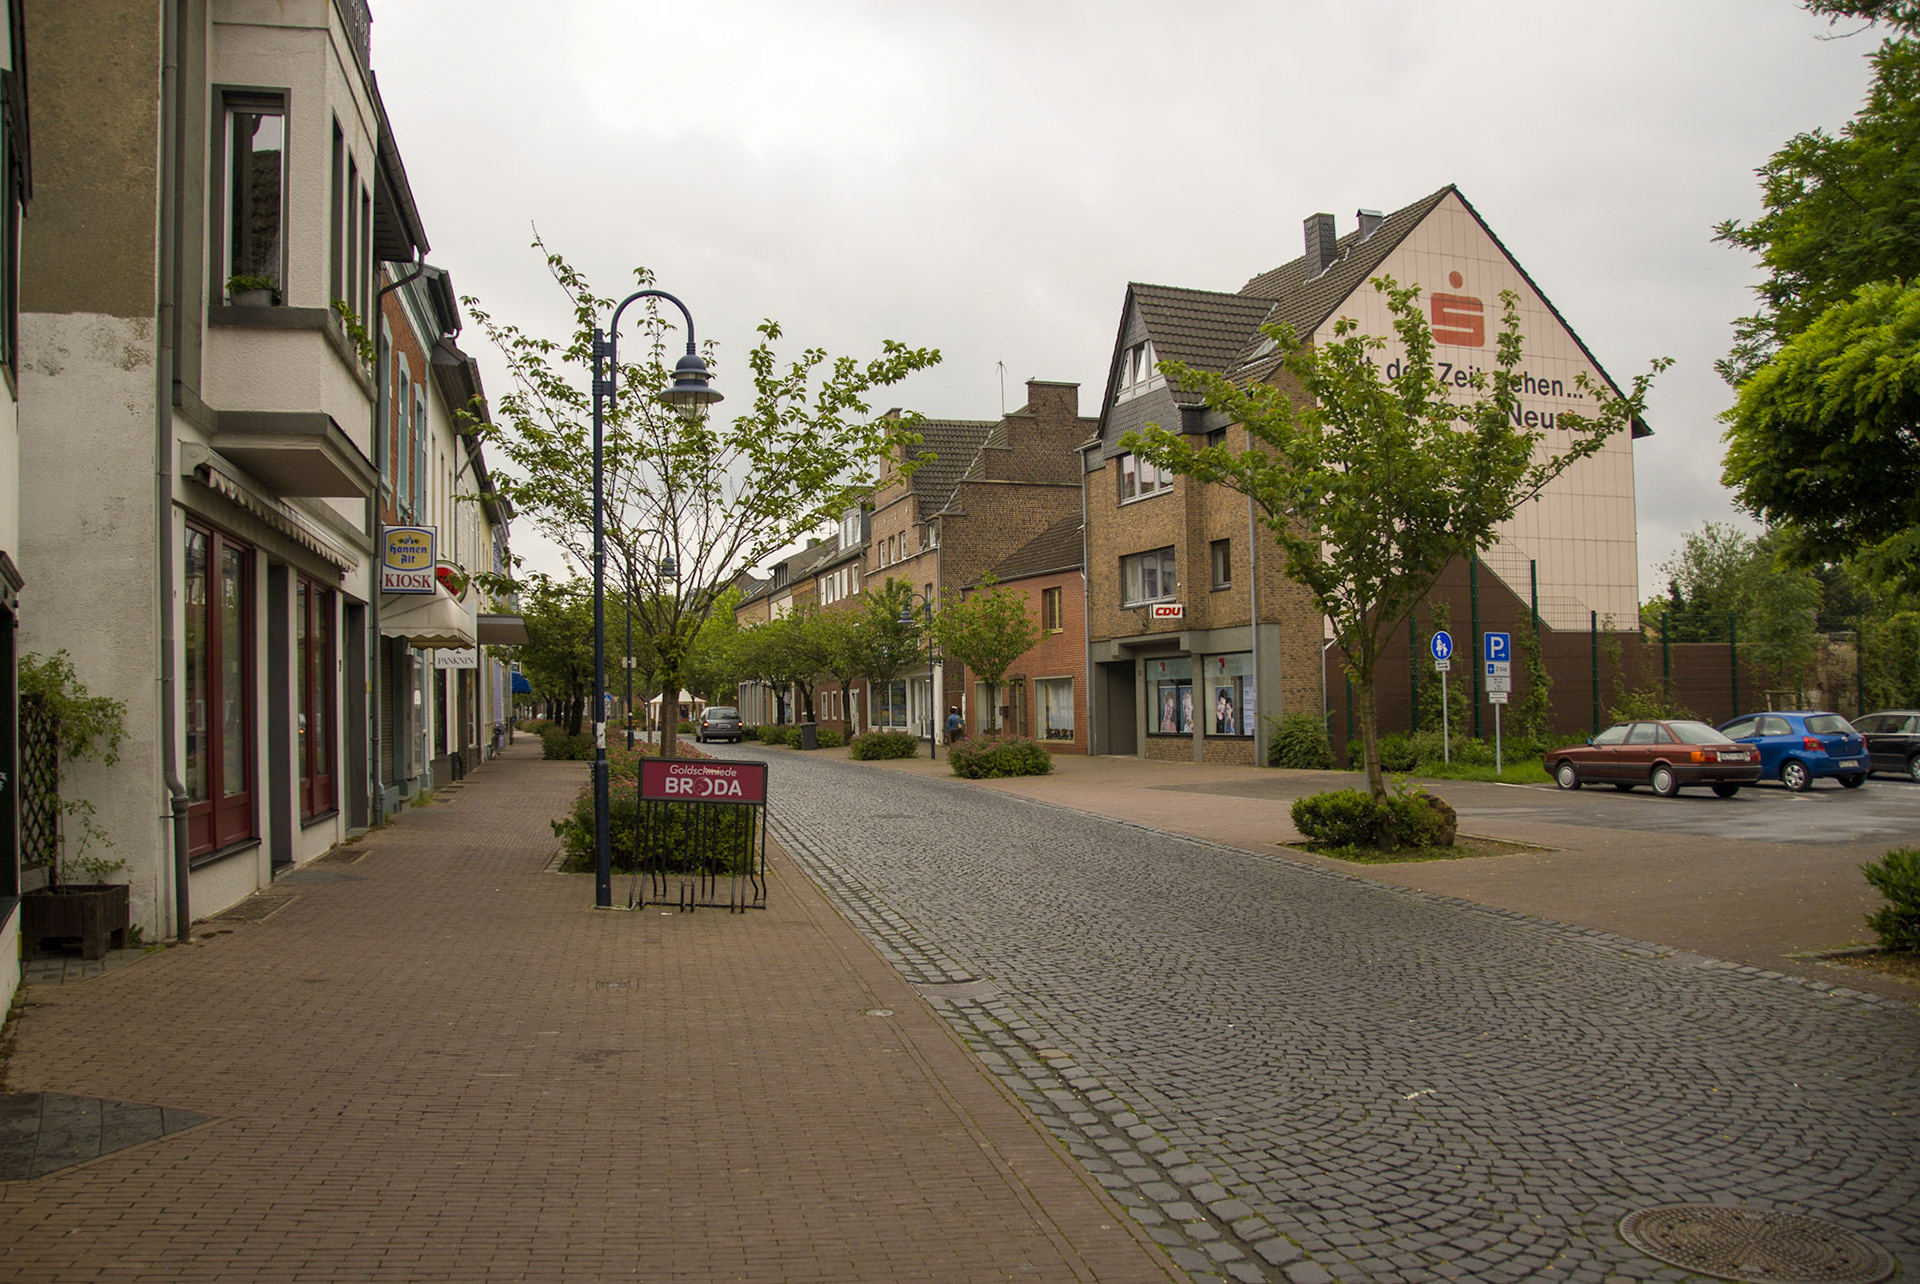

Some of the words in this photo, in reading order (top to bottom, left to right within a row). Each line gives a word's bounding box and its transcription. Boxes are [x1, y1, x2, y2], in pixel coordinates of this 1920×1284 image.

[385, 574, 432, 589] KIOSK
[1155, 607, 1181, 616] CDU
[1491, 637, 1504, 658] P
[438, 656, 474, 665] PANKNIN
[669, 764, 737, 777] Goldschmiede
[665, 777, 743, 797] BRODA
